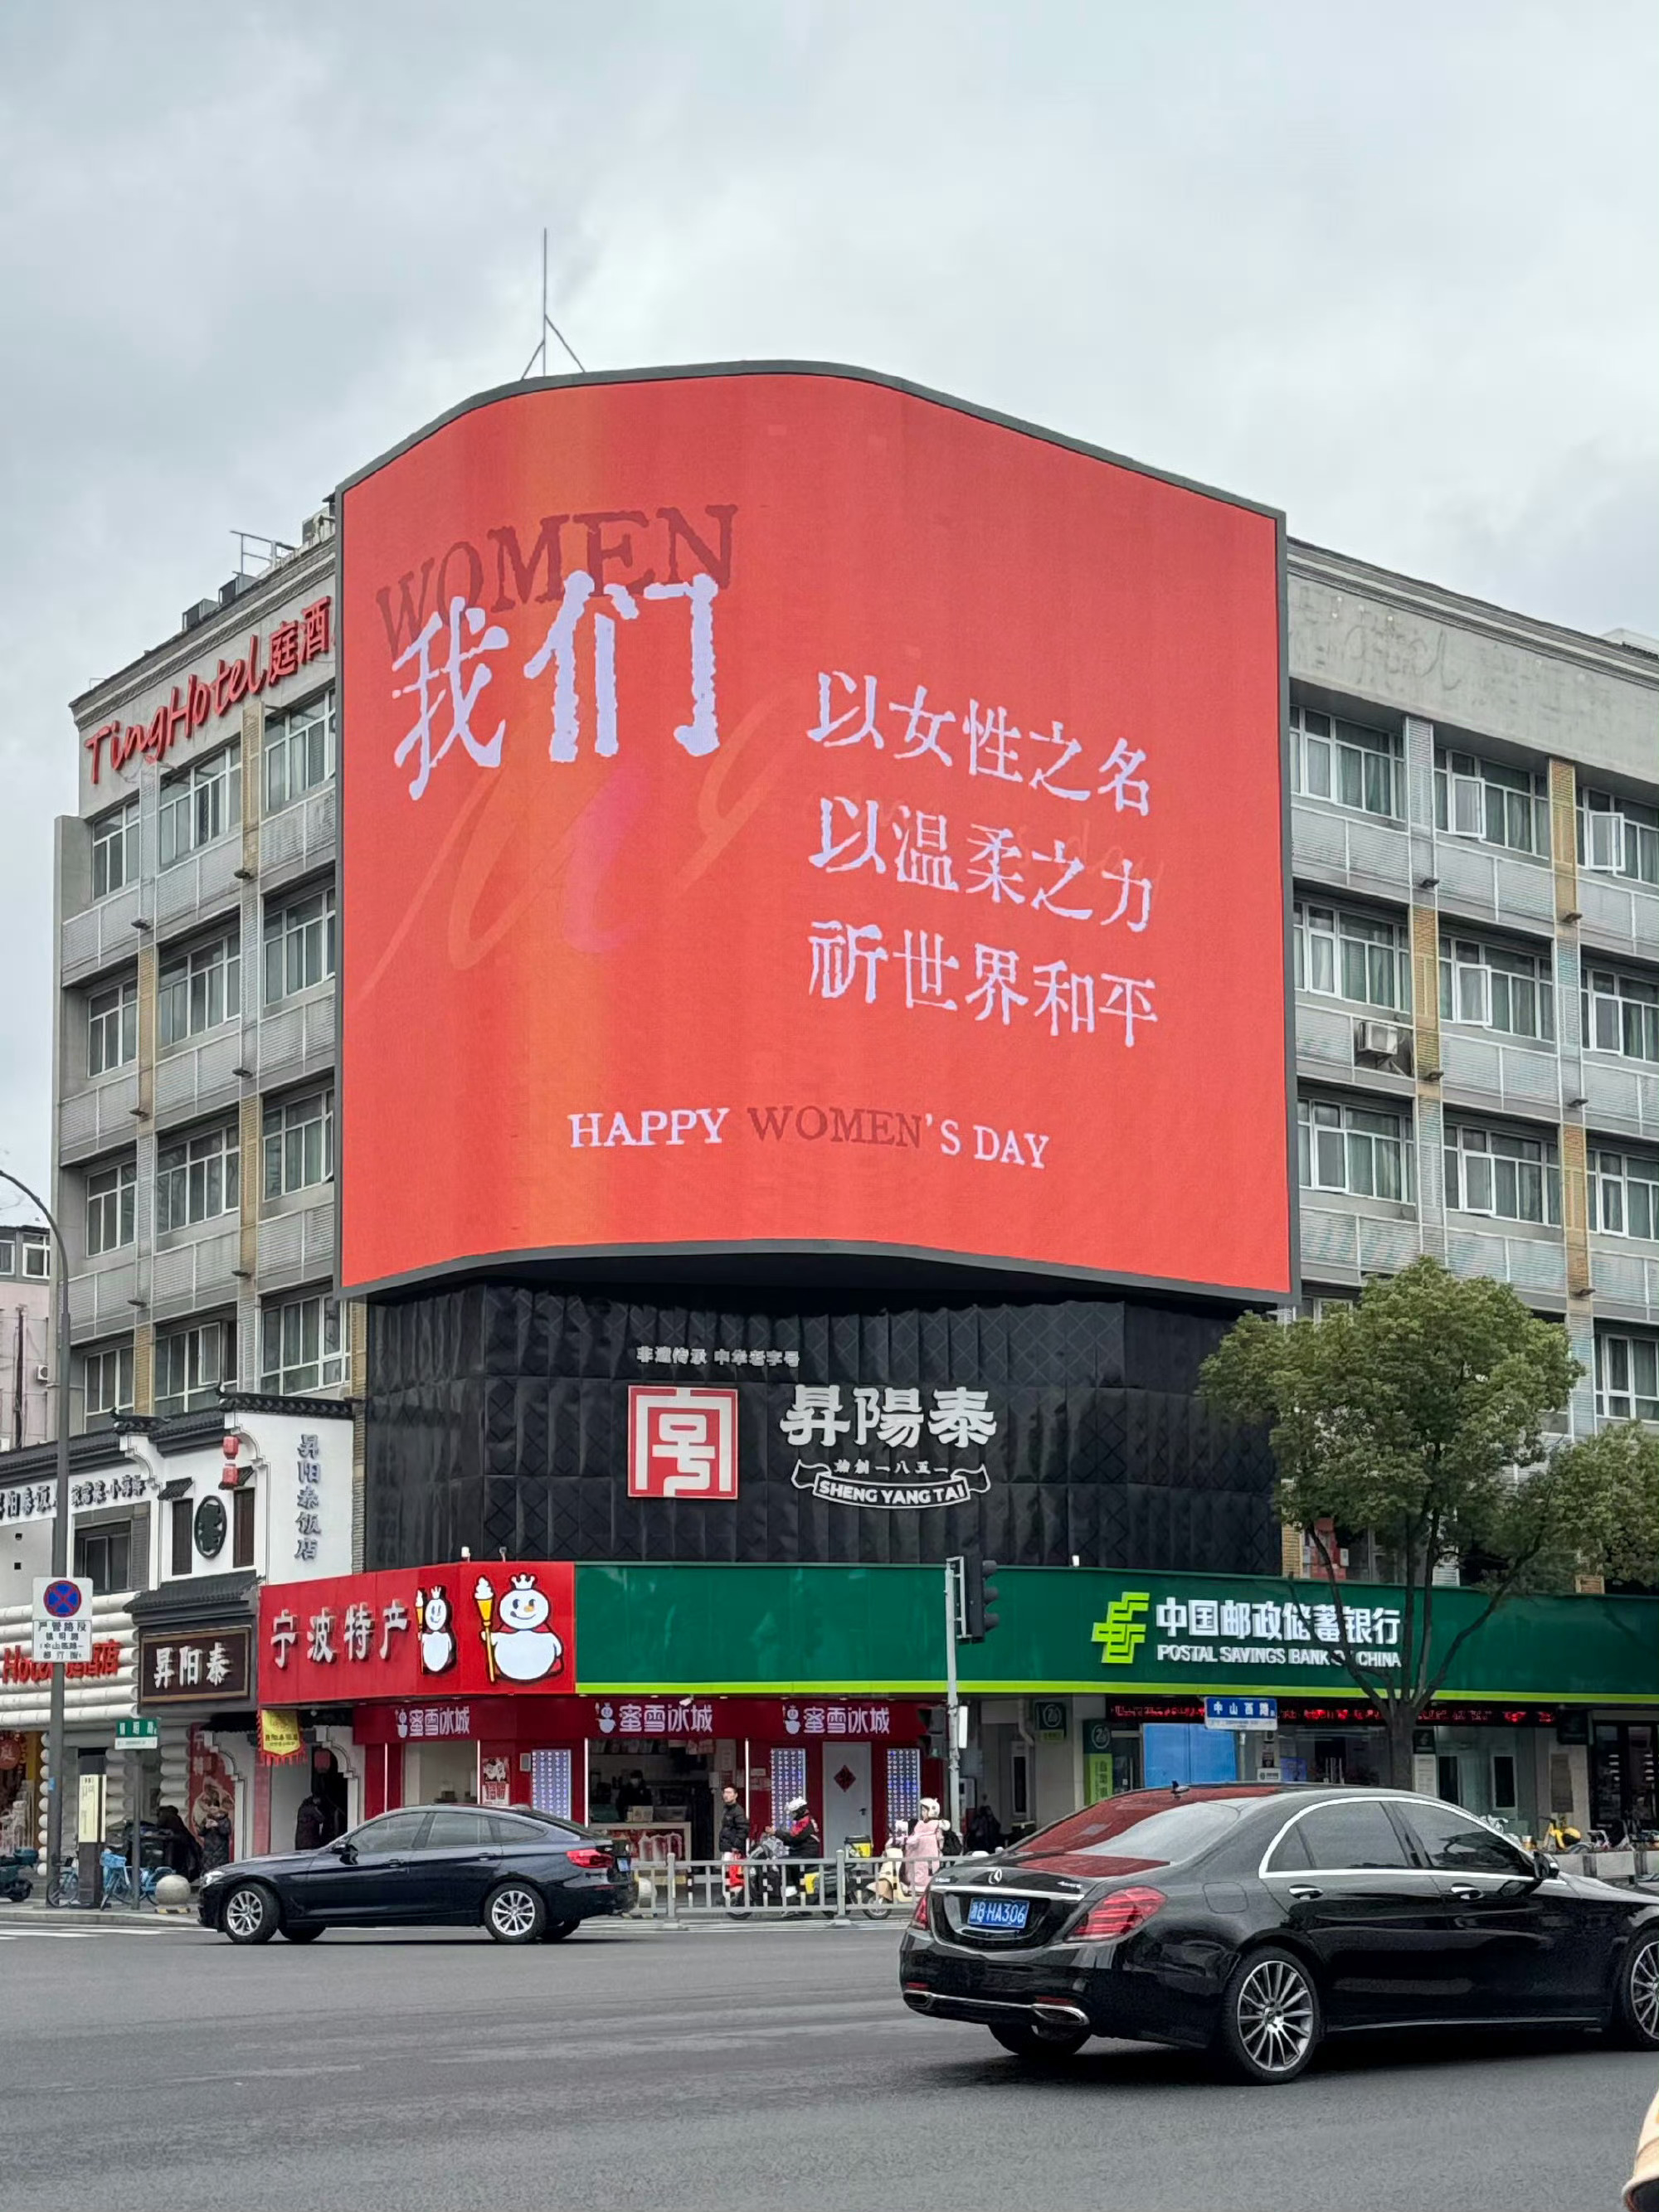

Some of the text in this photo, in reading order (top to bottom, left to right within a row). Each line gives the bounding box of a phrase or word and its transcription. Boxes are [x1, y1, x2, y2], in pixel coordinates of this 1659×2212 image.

[376, 503, 739, 662] WOMEN
[269, 596, 335, 687] 庭酒
[392, 570, 720, 801] 我们
[807, 670, 1151, 817] 以女性之名
[808, 796, 1153, 933] 以温柔之力
[808, 920, 1158, 1048] 祈世界和平
[567, 1105, 1049, 1169] HAPPY WOMEN'S DAY
[780, 1384, 997, 1448] 昇陽泰
[819, 1481, 967, 1505] SHENG YANG TAI
[270, 1598, 411, 1670] 宁波特产
[1155, 1597, 1401, 1645] 中国邮政储蓄银行
[153, 1641, 233, 1689] 昇阳泰
[1157, 1645, 1219, 1663] POSTAL
[1219, 1646, 1286, 1665] SAVINGS
[1287, 1649, 1331, 1666] BANK
[1356, 1650, 1402, 1668] CHINA
[409, 1705, 470, 1737] 蜜雪冰城
[619, 1704, 713, 1733] 蜜雪冰城
[803, 1706, 890, 1734] 蜜雪冰城
